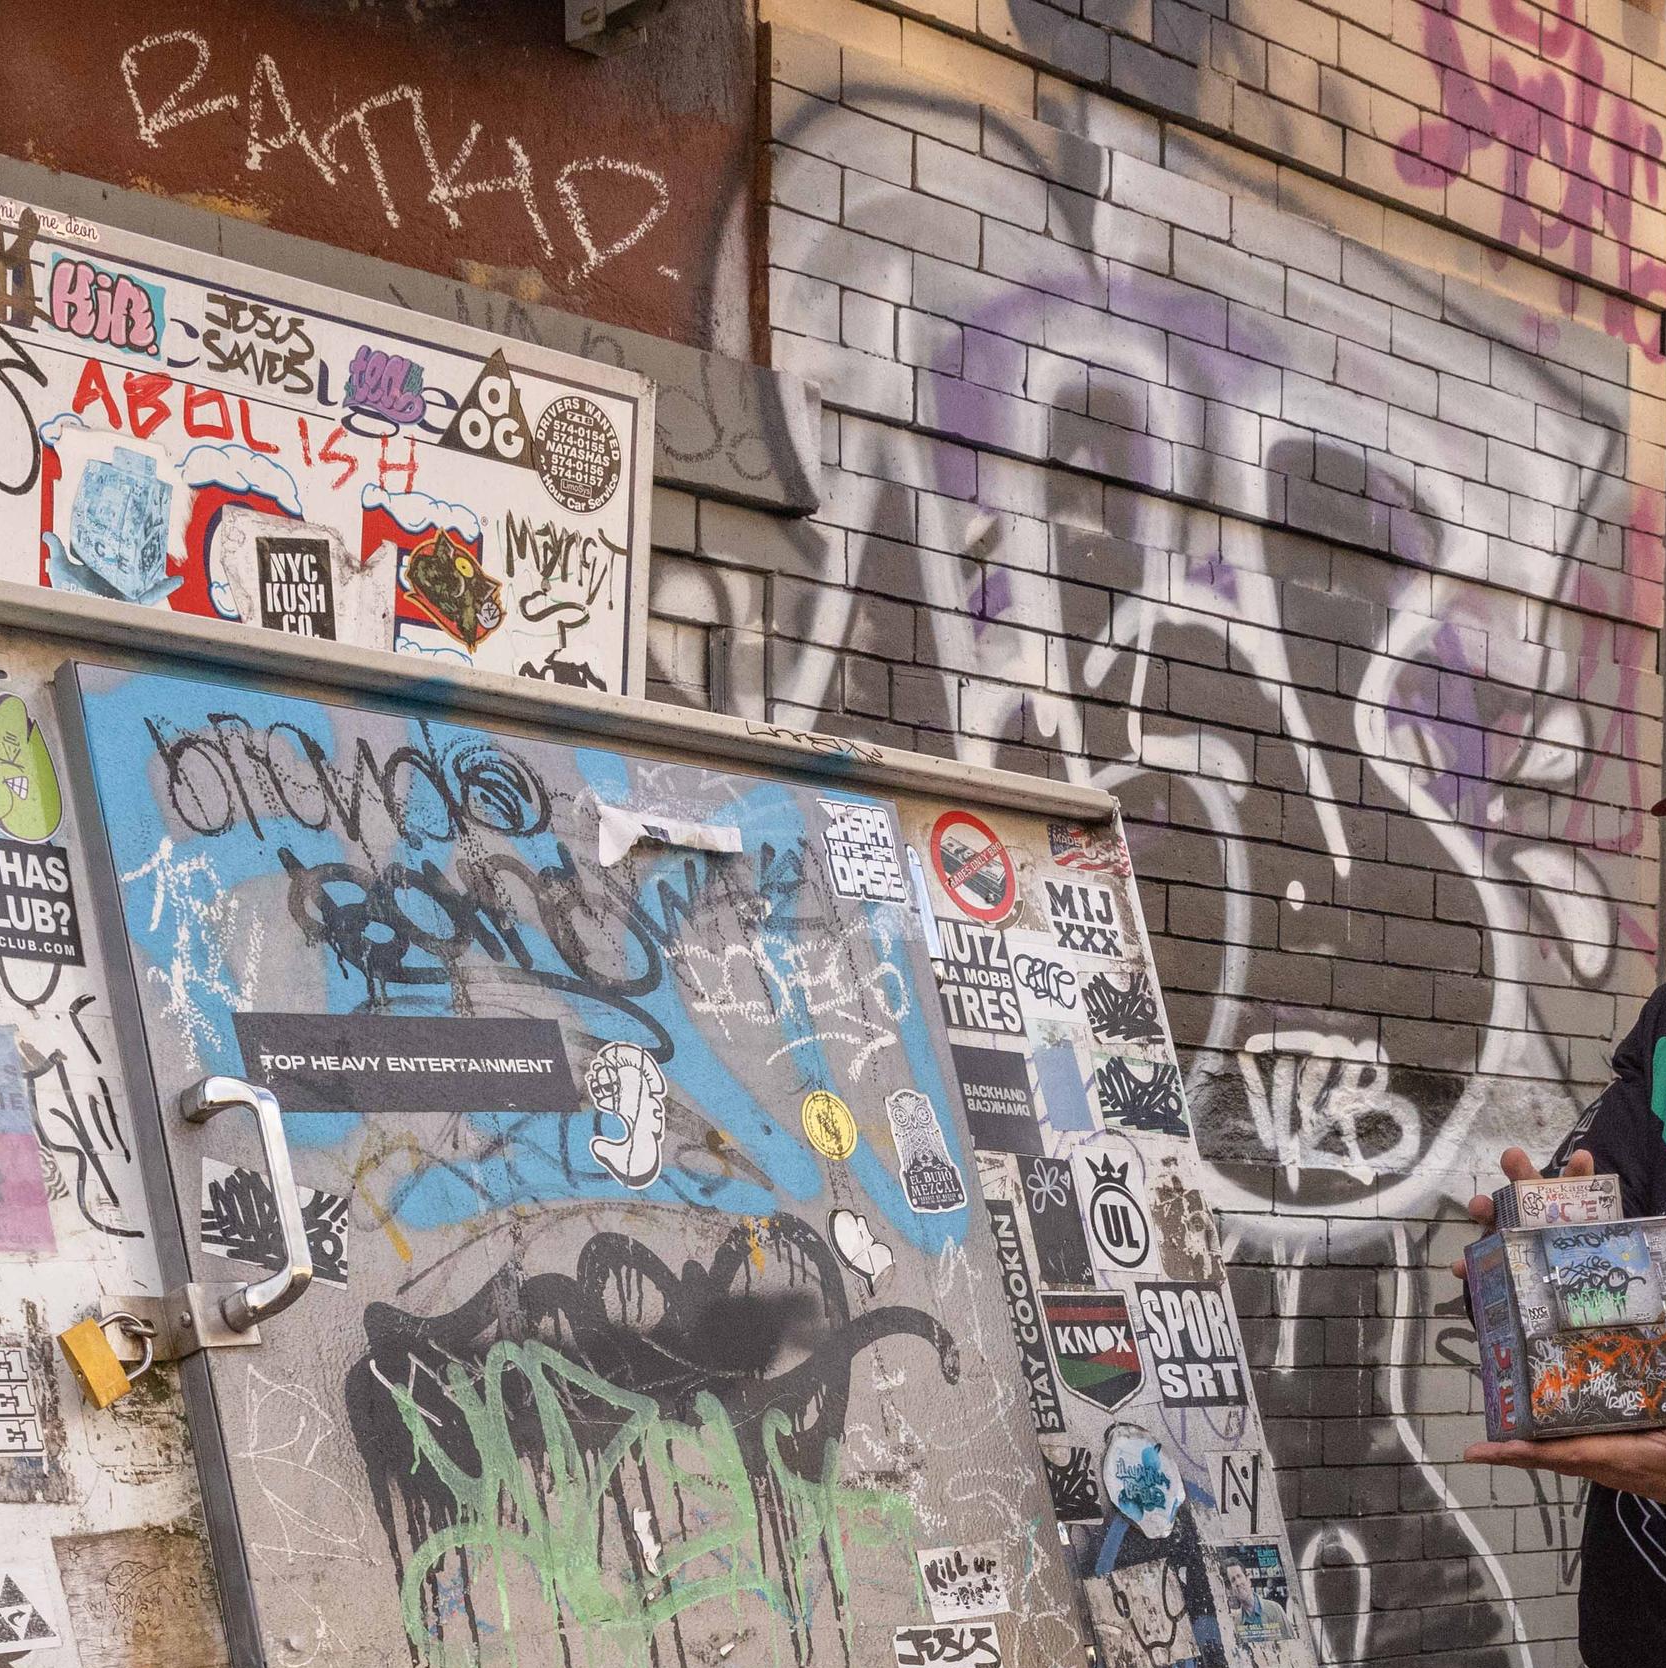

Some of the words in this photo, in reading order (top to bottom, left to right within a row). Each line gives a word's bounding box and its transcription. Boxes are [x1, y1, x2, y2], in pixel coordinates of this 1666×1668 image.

[71, 357, 420, 494] ABOLISH
[536, 397, 581, 442] DRIVERS
[583, 397, 621, 461] WANTED
[552, 419, 607, 444] 574-0154
[545, 440, 611, 468] NATASHAS
[551, 430, 606, 455] 574-0155
[549, 465, 605, 488] 574-0157
[550, 455, 605, 478] 574-0156
[542, 472, 567, 503] Hour
[566, 495, 587, 512] Car
[588, 472, 620, 510] Service
[269, 552, 319, 583] NYC
[265, 582, 326, 614] KUSH
[971, 852, 991, 876] ONLY
[1044, 879, 1115, 926] MIJ
[1052, 919, 1125, 958] XXX
[962, 966, 1014, 989] MOBB
[939, 983, 1023, 1034] TRES
[260, 1053, 307, 1073] TOP
[311, 1055, 381, 1073] HEAVY
[386, 1056, 554, 1076] ENTERTAINMENT
[962, 1083, 1027, 1102] BACKHAND
[910, 1173, 924, 1186] EL
[910, 1180, 960, 1198] MEZCAL
[1054, 1325, 1134, 1357] KNOX
[1026, 1353, 1060, 1430] STAY
[1158, 1361, 1240, 1401] SRT
[924, 1550, 968, 1593] Kill
[973, 1556, 997, 1575] ur
